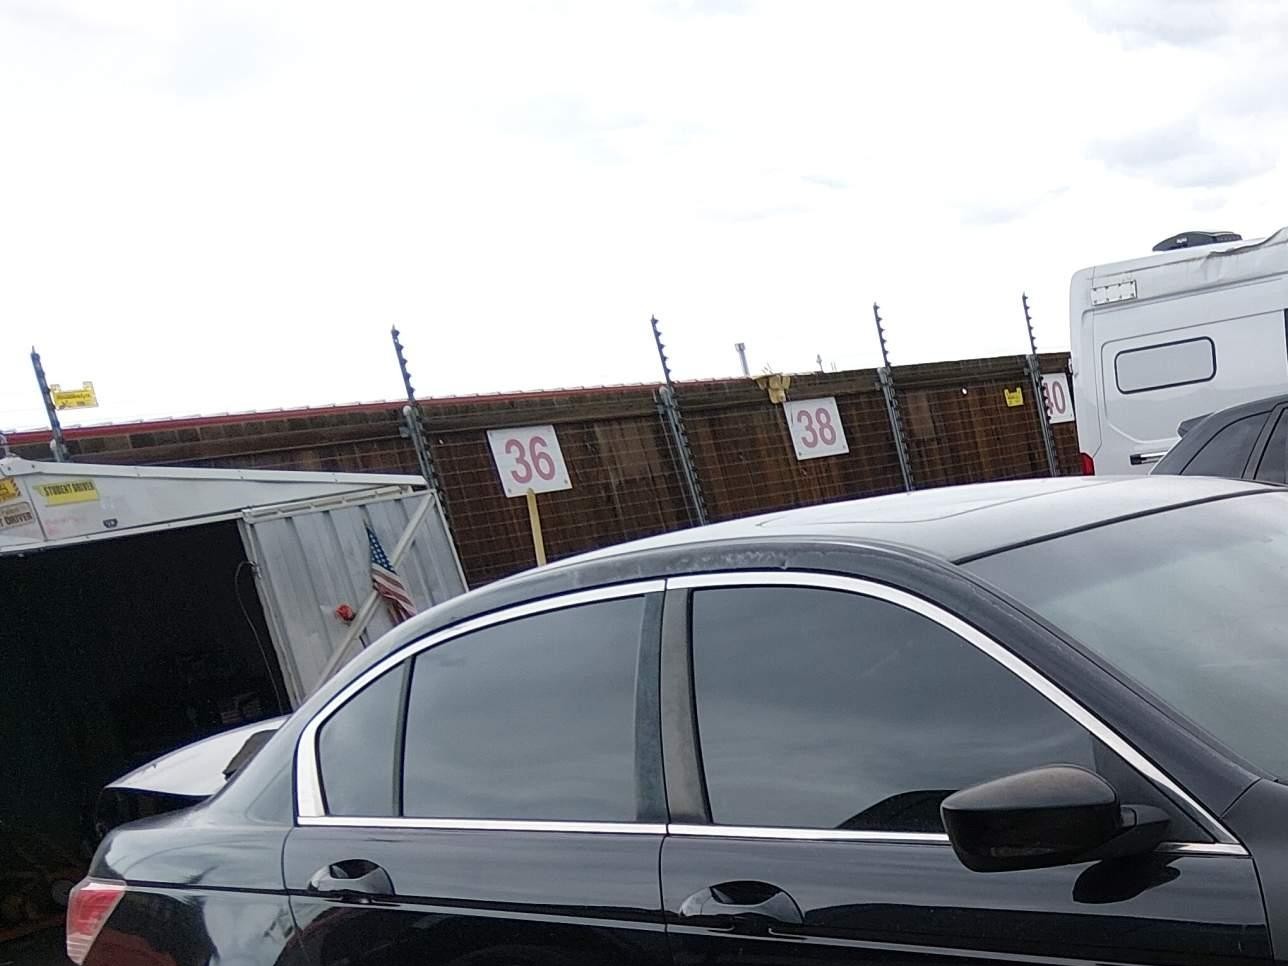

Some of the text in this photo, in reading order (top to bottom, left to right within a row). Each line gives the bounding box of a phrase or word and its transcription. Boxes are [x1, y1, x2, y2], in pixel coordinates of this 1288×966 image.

[796, 407, 837, 449] 38
[505, 435, 556, 484] 36
[43, 483, 73, 497] STUDENT
